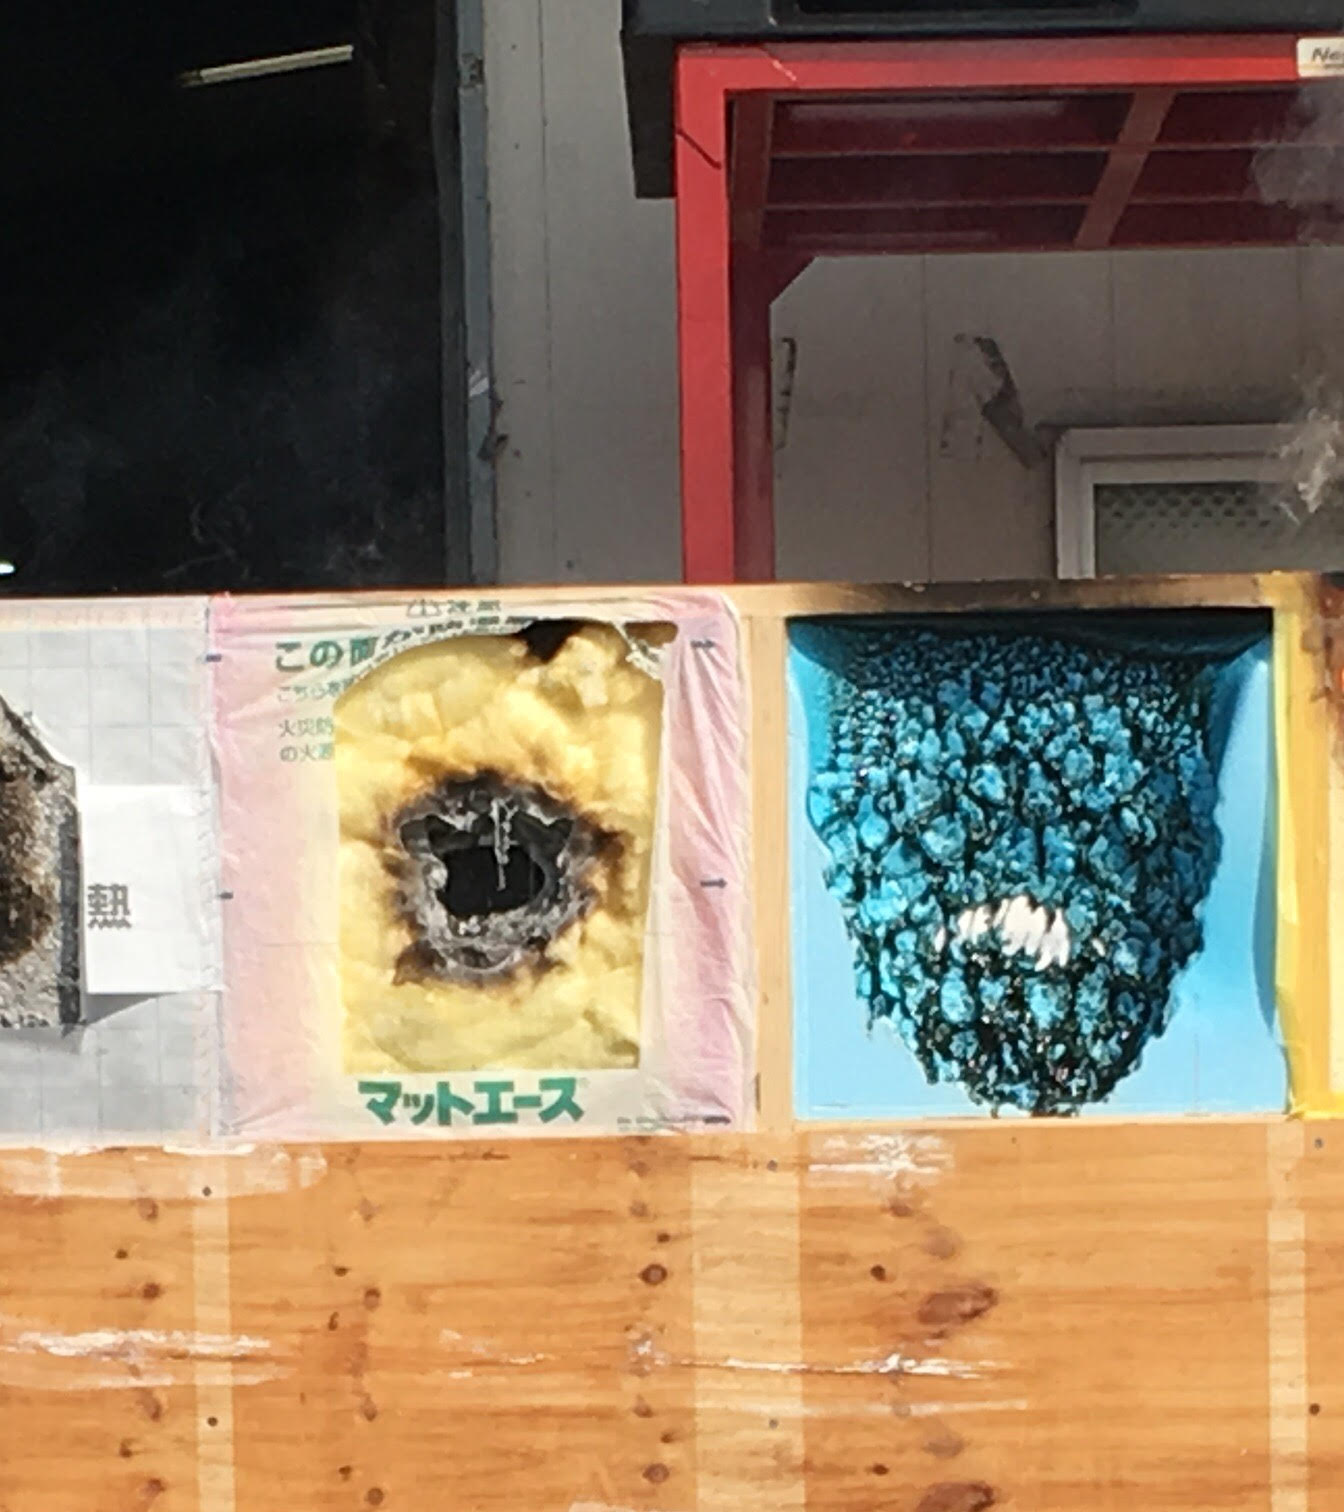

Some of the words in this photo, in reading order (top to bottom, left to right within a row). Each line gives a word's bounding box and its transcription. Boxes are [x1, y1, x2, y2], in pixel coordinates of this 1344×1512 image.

[87, 884, 132, 930] 熱
[358, 1076, 584, 1126] マットエース
